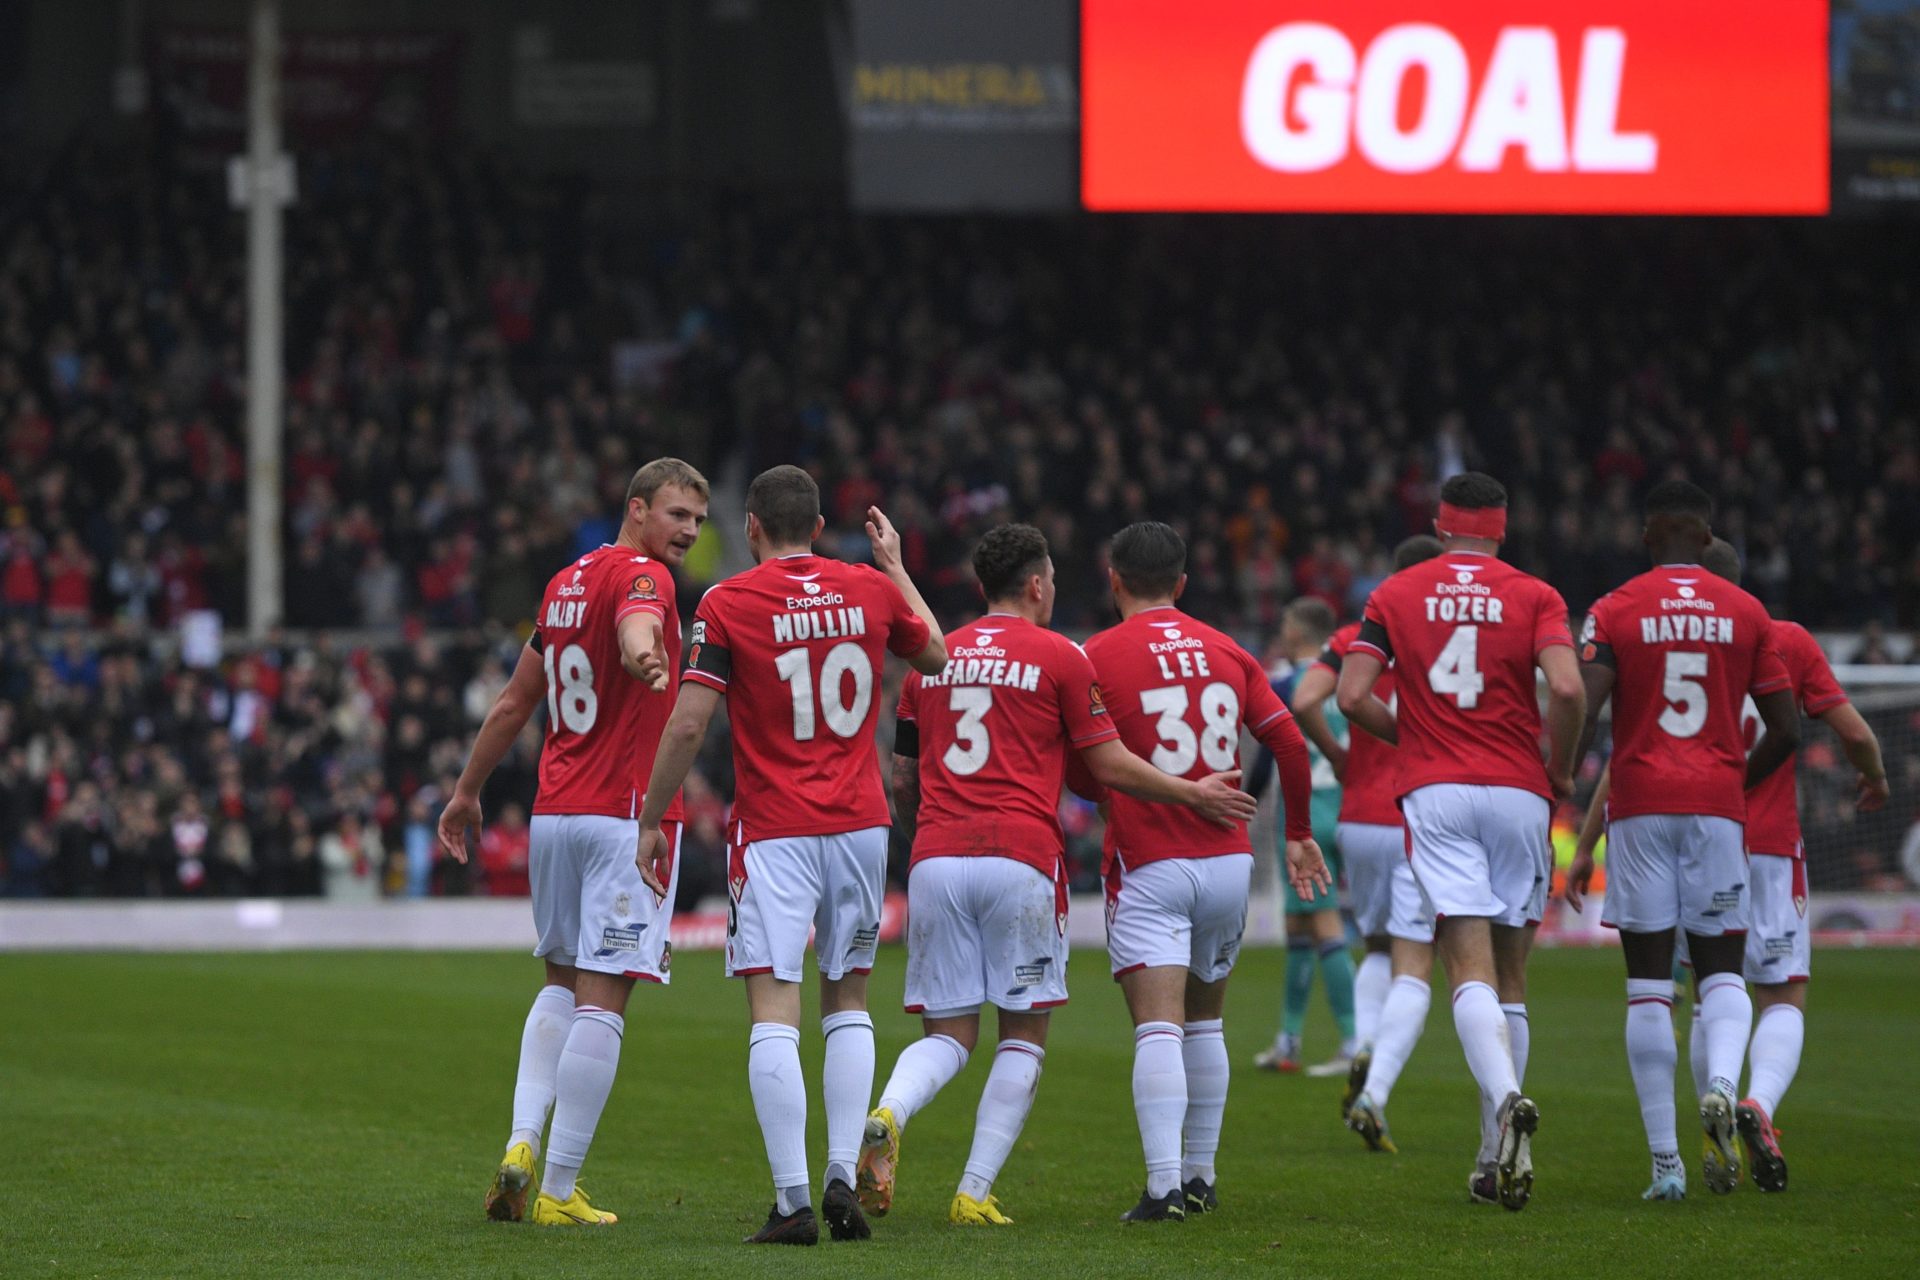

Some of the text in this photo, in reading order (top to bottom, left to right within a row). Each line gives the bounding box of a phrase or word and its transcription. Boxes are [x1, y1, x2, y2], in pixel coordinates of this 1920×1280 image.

[1240, 22, 1659, 173] GOAL
[786, 592, 843, 610] Expedia
[1436, 582, 1491, 596] Expedia
[546, 601, 588, 628] DALBY
[1424, 597, 1504, 623] TOZER
[1660, 598, 1715, 612] Expedia
[772, 606, 866, 643] MULLIN
[1640, 615, 1734, 644] HAYDEN
[953, 645, 1006, 658] Expedia
[1149, 637, 1204, 654] Expedia
[1157, 651, 1211, 680] LEE
[1428, 624, 1485, 709] 4
[544, 643, 598, 735] 18
[775, 641, 874, 741] 10
[1658, 651, 1709, 739] 5
[942, 686, 993, 776] 3
[1139, 682, 1240, 776] 38
[604, 938, 636, 948] Trailers
